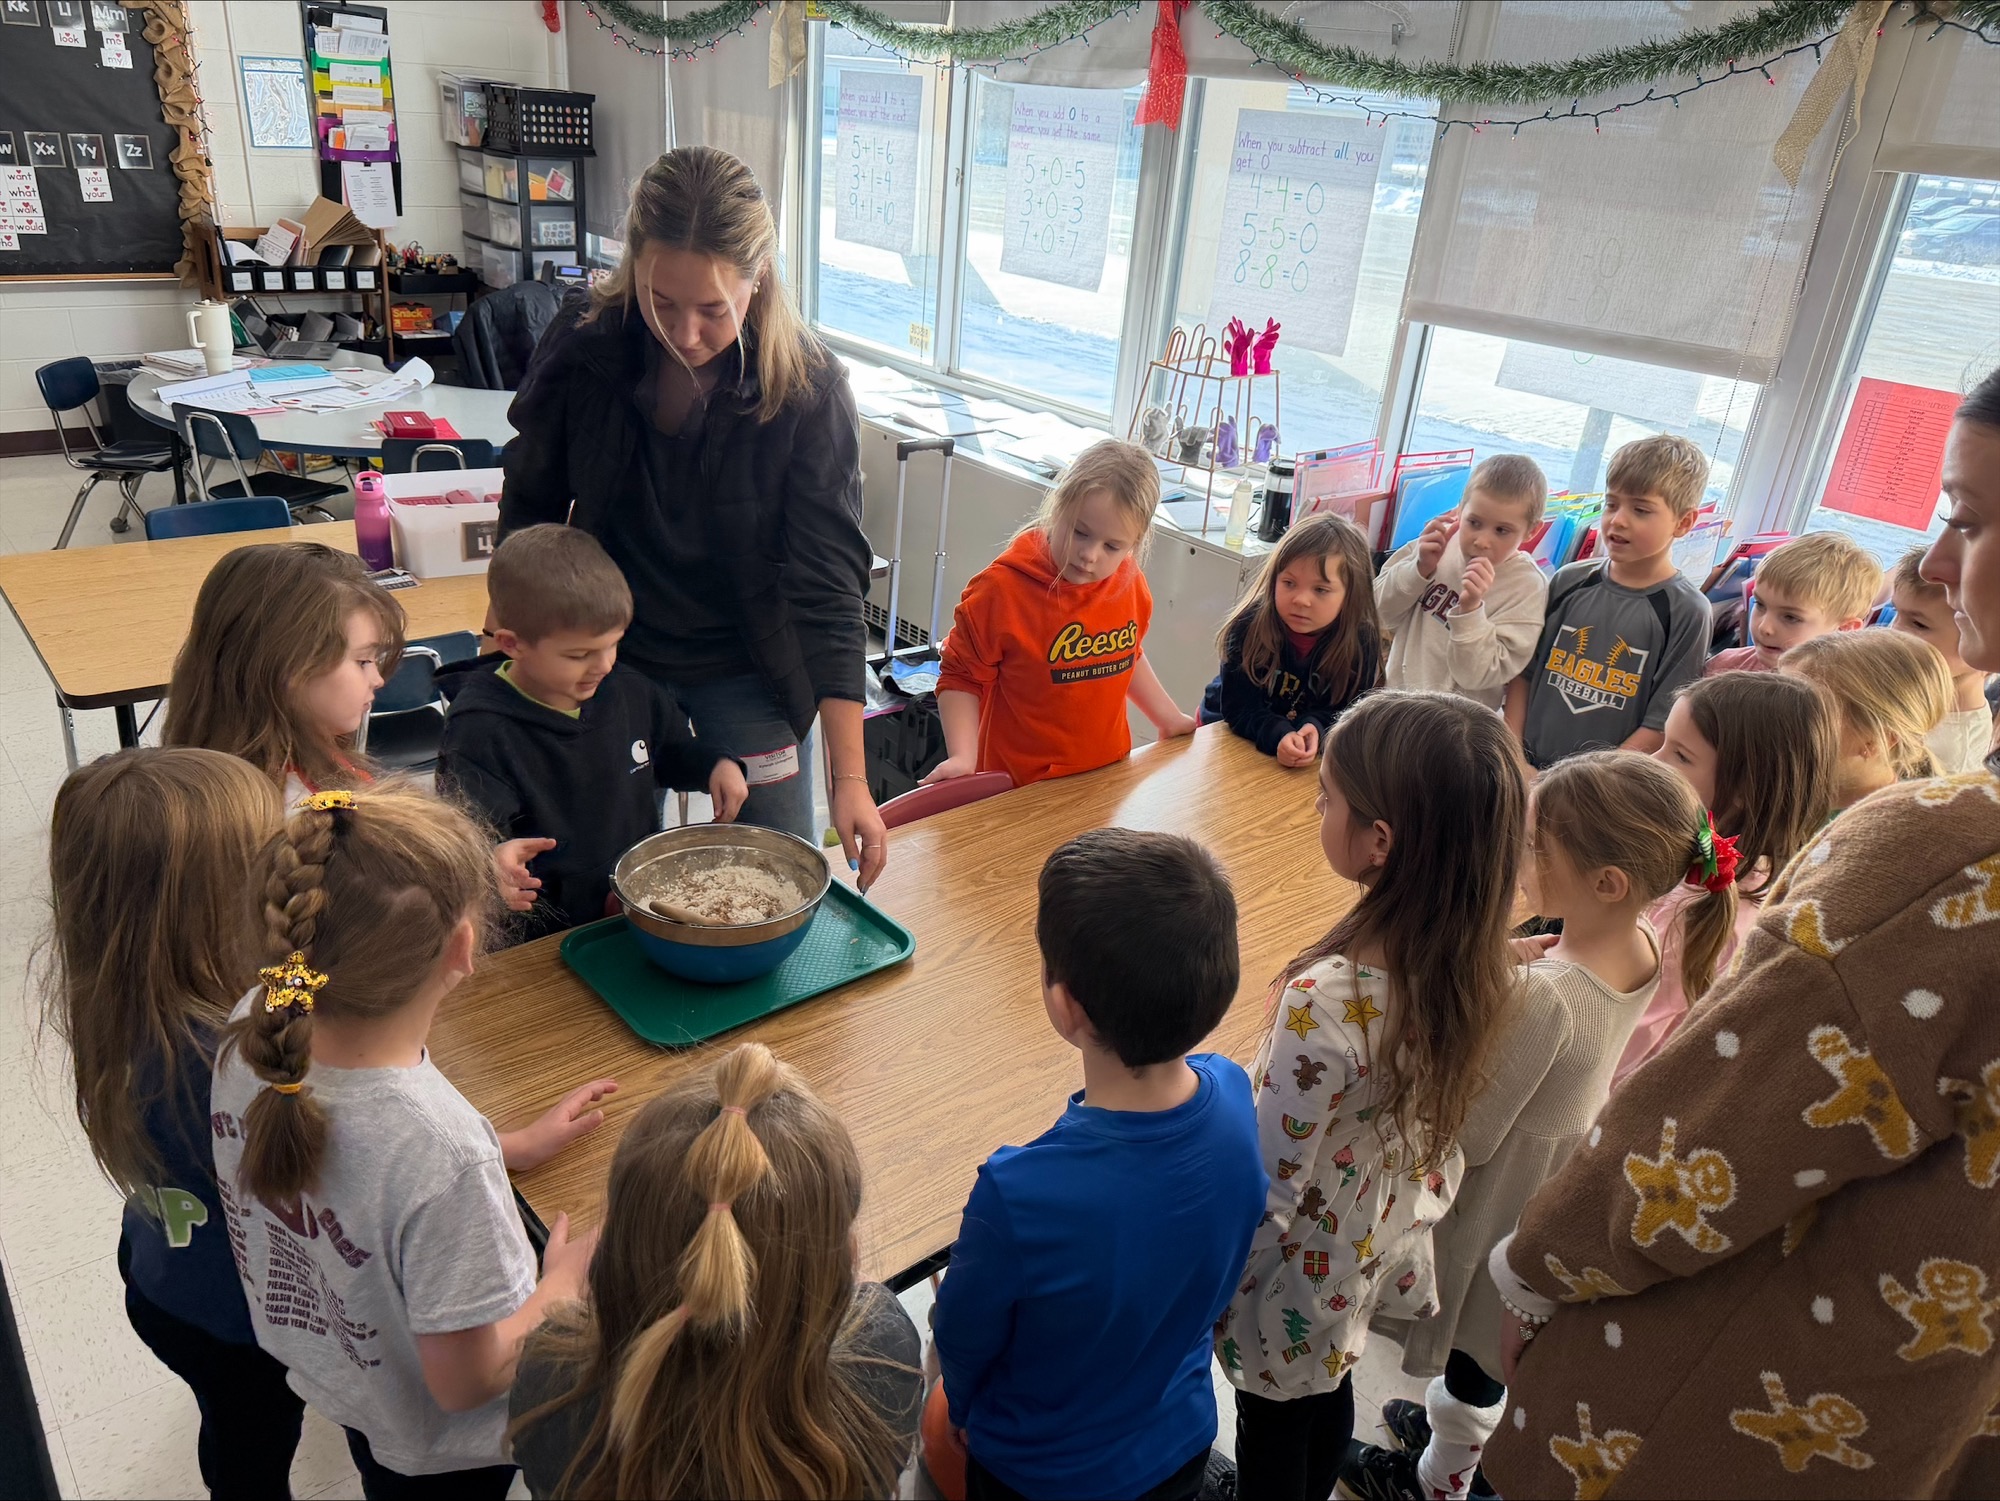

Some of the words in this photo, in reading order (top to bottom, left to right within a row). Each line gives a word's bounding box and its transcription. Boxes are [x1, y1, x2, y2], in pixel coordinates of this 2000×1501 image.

[94, 5, 125, 20] Mm
[59, 32, 79, 43] look
[105, 37, 122, 45] me
[107, 57, 122, 65] my
[1014, 101, 1034, 117] When
[1037, 110, 1049, 121] you
[1052, 105, 1065, 120] add
[1081, 108, 1089, 122] to
[1095, 115, 1101, 123] a
[1039, 126, 1050, 137] you
[1052, 123, 1063, 140] get
[1067, 124, 1079, 139] the
[1083, 131, 1101, 142] same
[33, 141, 56, 156] Xx
[77, 143, 97, 160] Yy
[125, 143, 143, 157] Zz
[1238, 132, 1262, 150] When
[1267, 140, 1283, 156] you
[1288, 138, 1326, 157] subtract
[1355, 151, 1375, 166] you
[1236, 153, 1253, 172] get
[7, 172, 32, 180] want
[85, 176, 102, 184] you
[9, 187, 37, 197] what
[85, 192, 107, 200] your
[16, 205, 38, 214] walk
[17, 223, 44, 231] would
[1048, 620, 1137, 664] Reese's
[1061, 669, 1090, 681] PEANUT
[1092, 663, 1117, 676] BUTTER
[1545, 647, 1642, 698] EAGLES
[1554, 675, 1617, 706] BASEBALL
